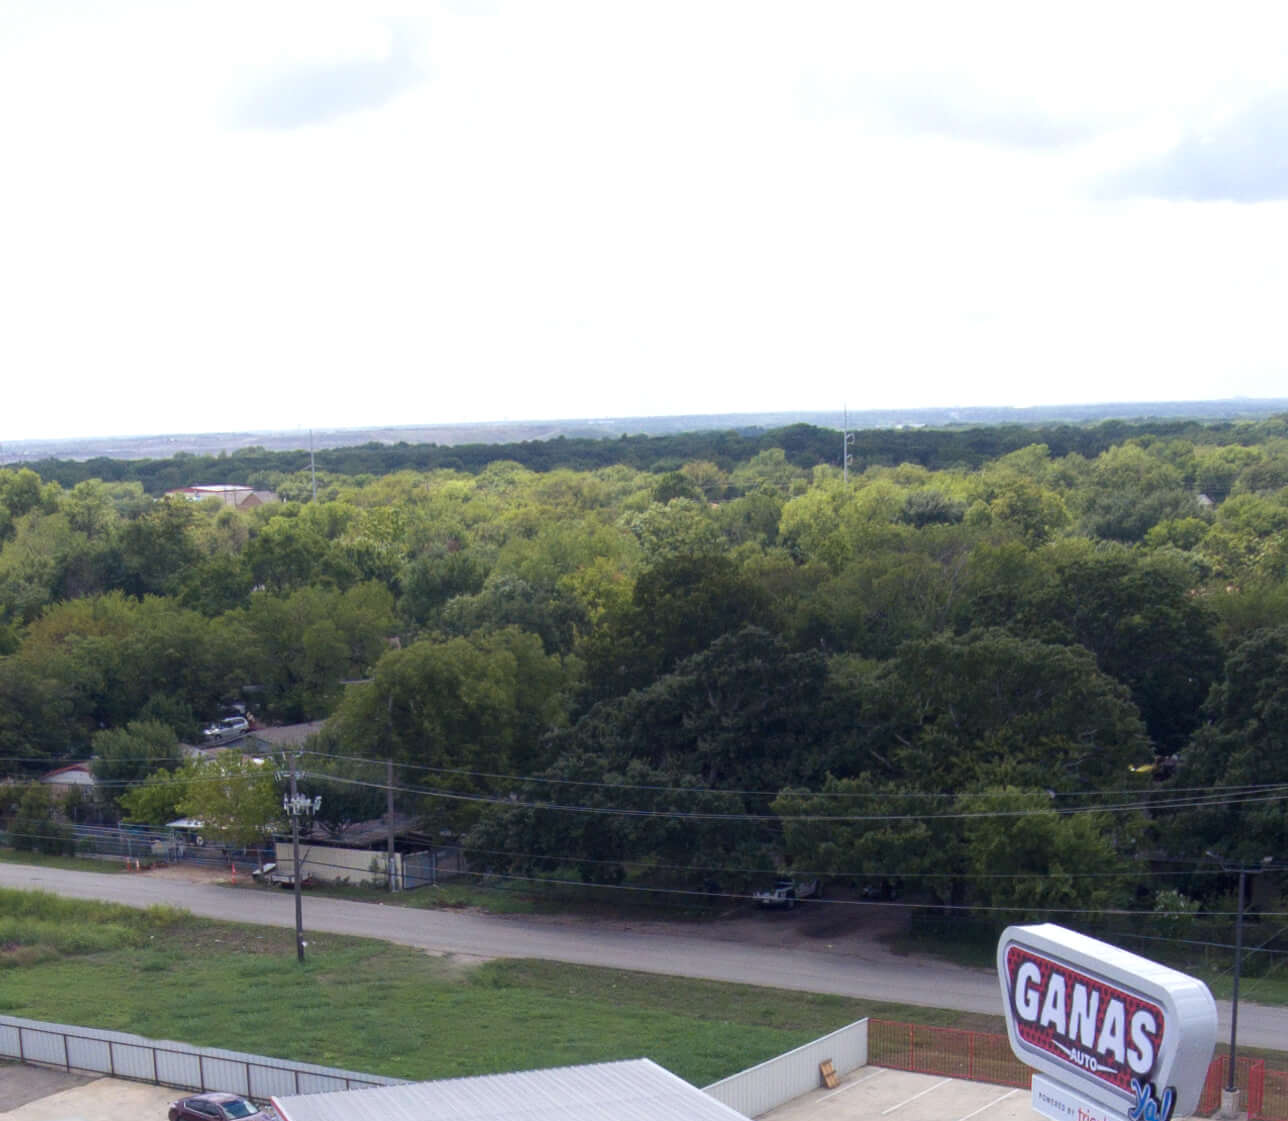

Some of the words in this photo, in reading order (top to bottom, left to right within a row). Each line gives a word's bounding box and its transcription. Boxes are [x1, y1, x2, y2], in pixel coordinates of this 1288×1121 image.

[1015, 962, 1158, 1074] GANAS
[1069, 1047, 1098, 1072] AUTO
[1038, 1091, 1066, 1112] POWERED
